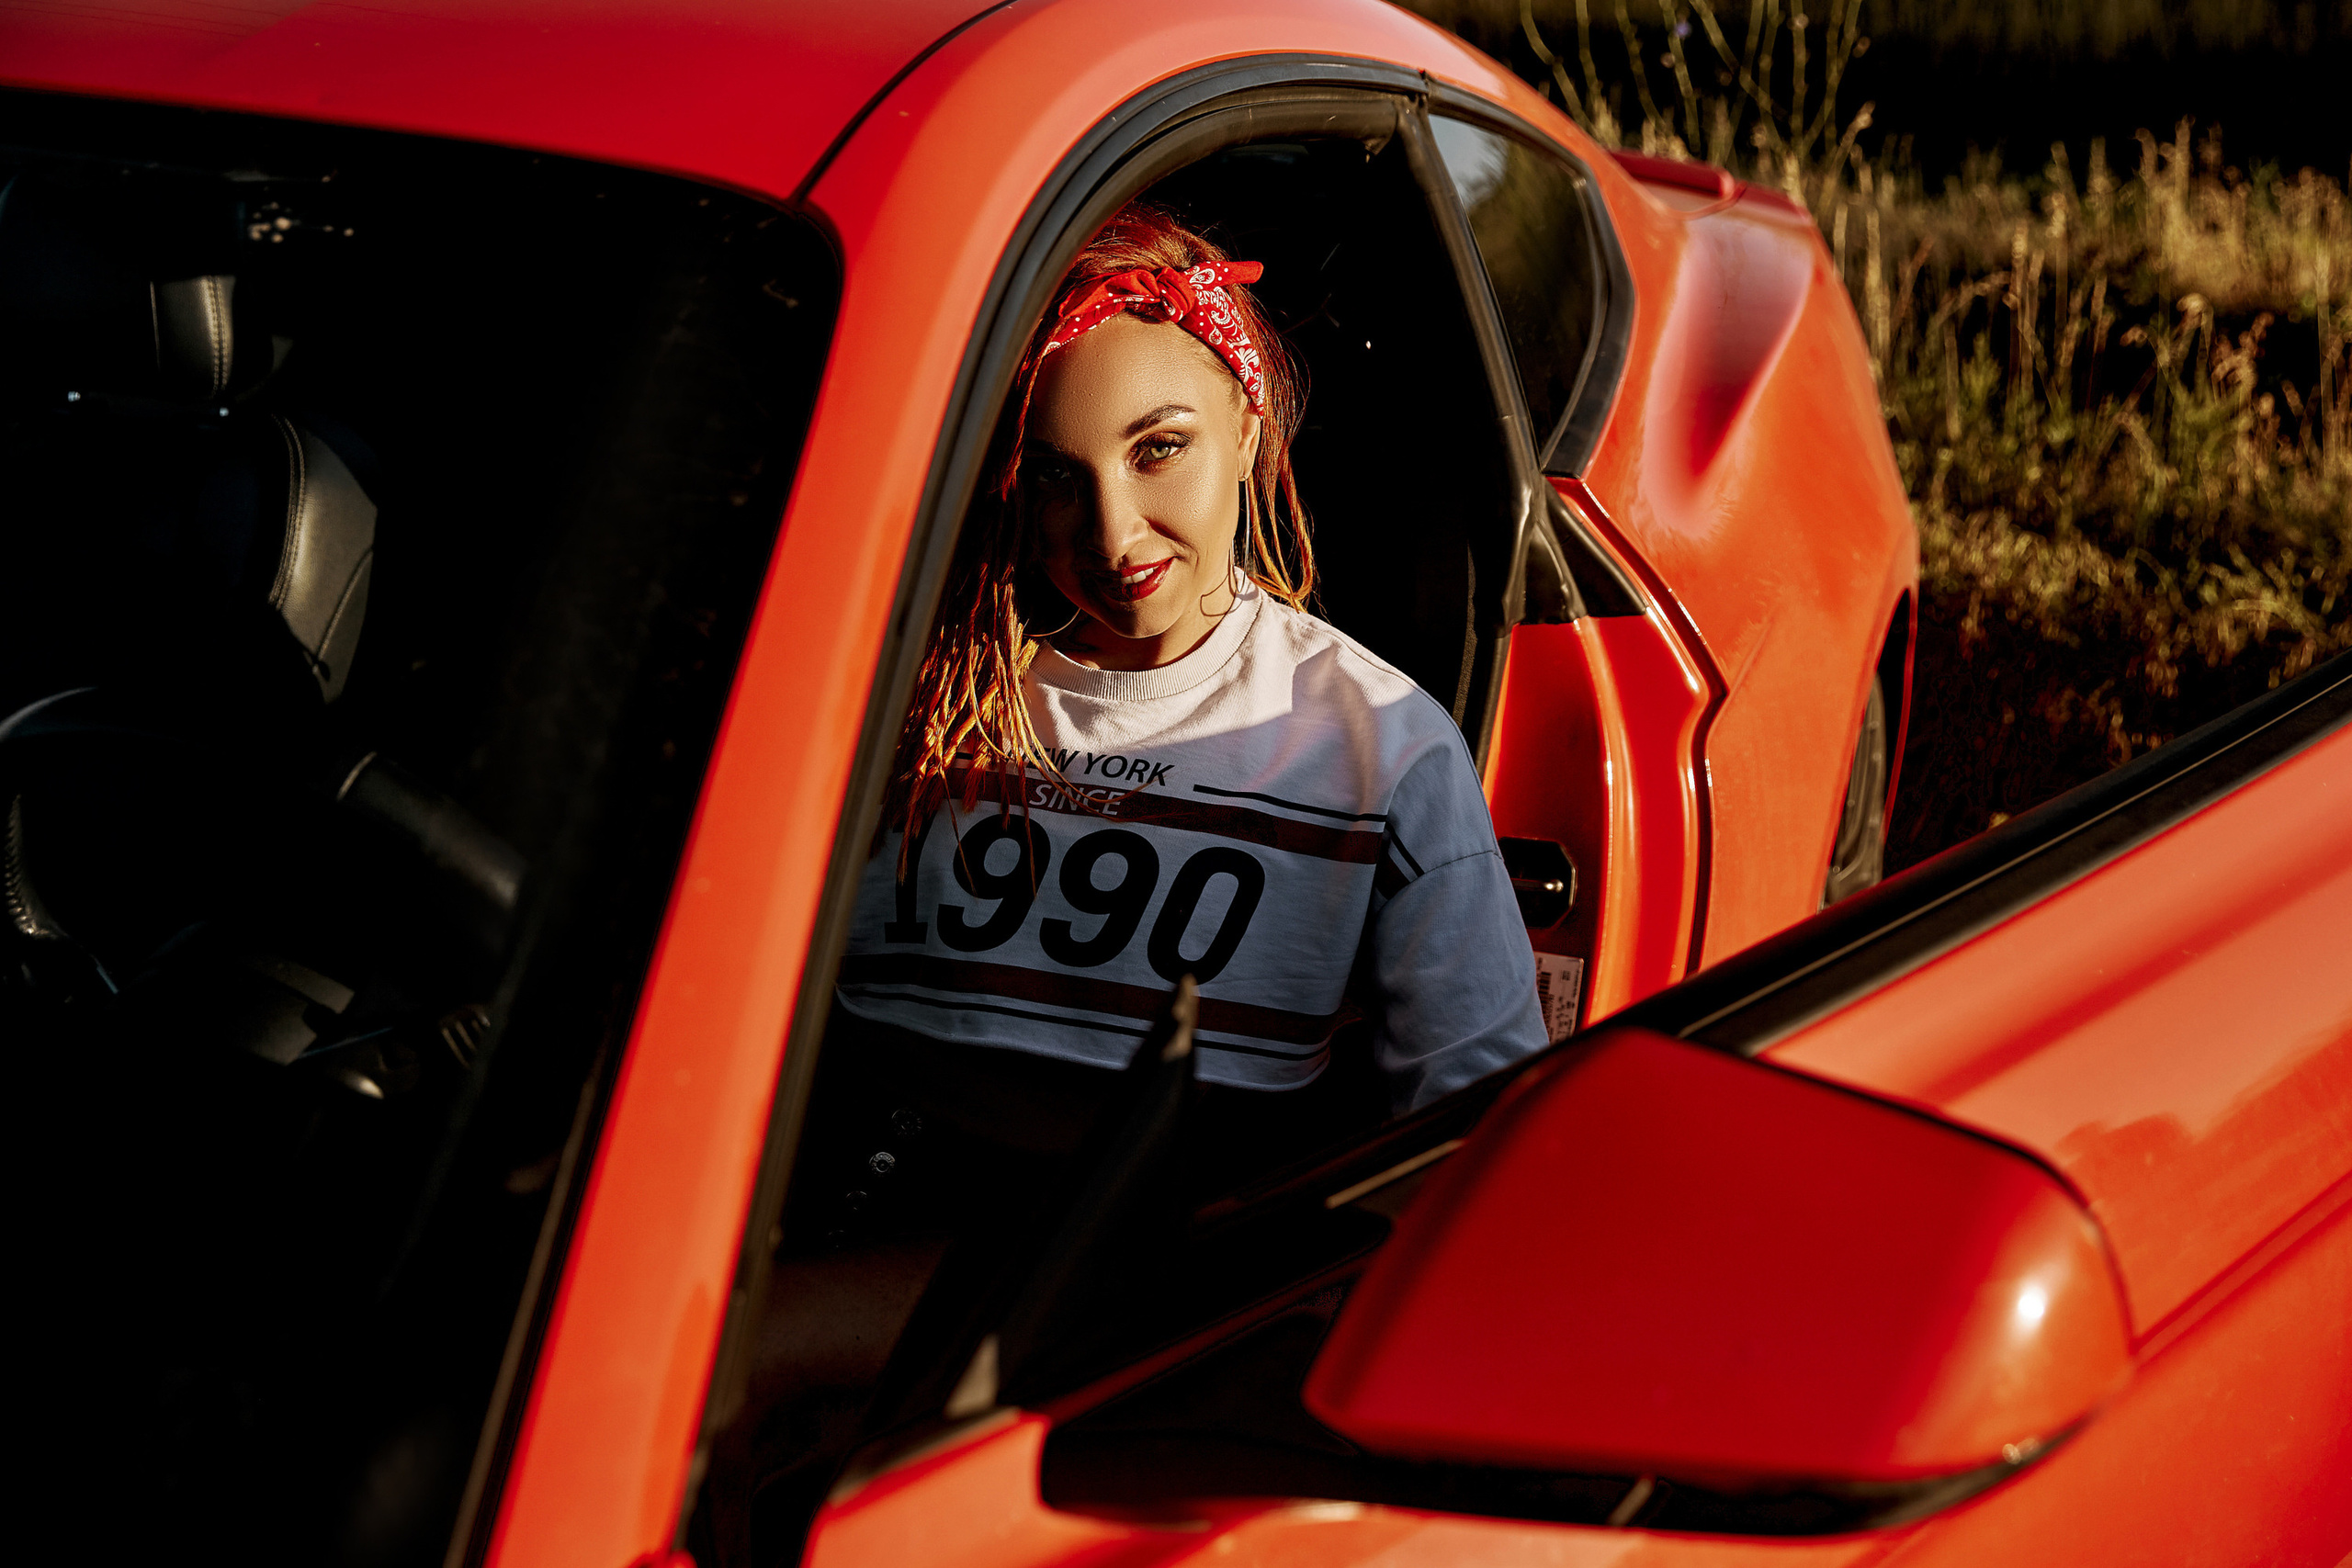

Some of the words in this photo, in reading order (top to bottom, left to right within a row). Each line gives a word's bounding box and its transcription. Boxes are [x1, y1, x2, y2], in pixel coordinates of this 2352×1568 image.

[1008, 746, 1080, 773] EW
[1083, 751, 1175, 787] YORK
[1029, 784, 1125, 816] SINCE
[884, 810, 1265, 986] 1990
